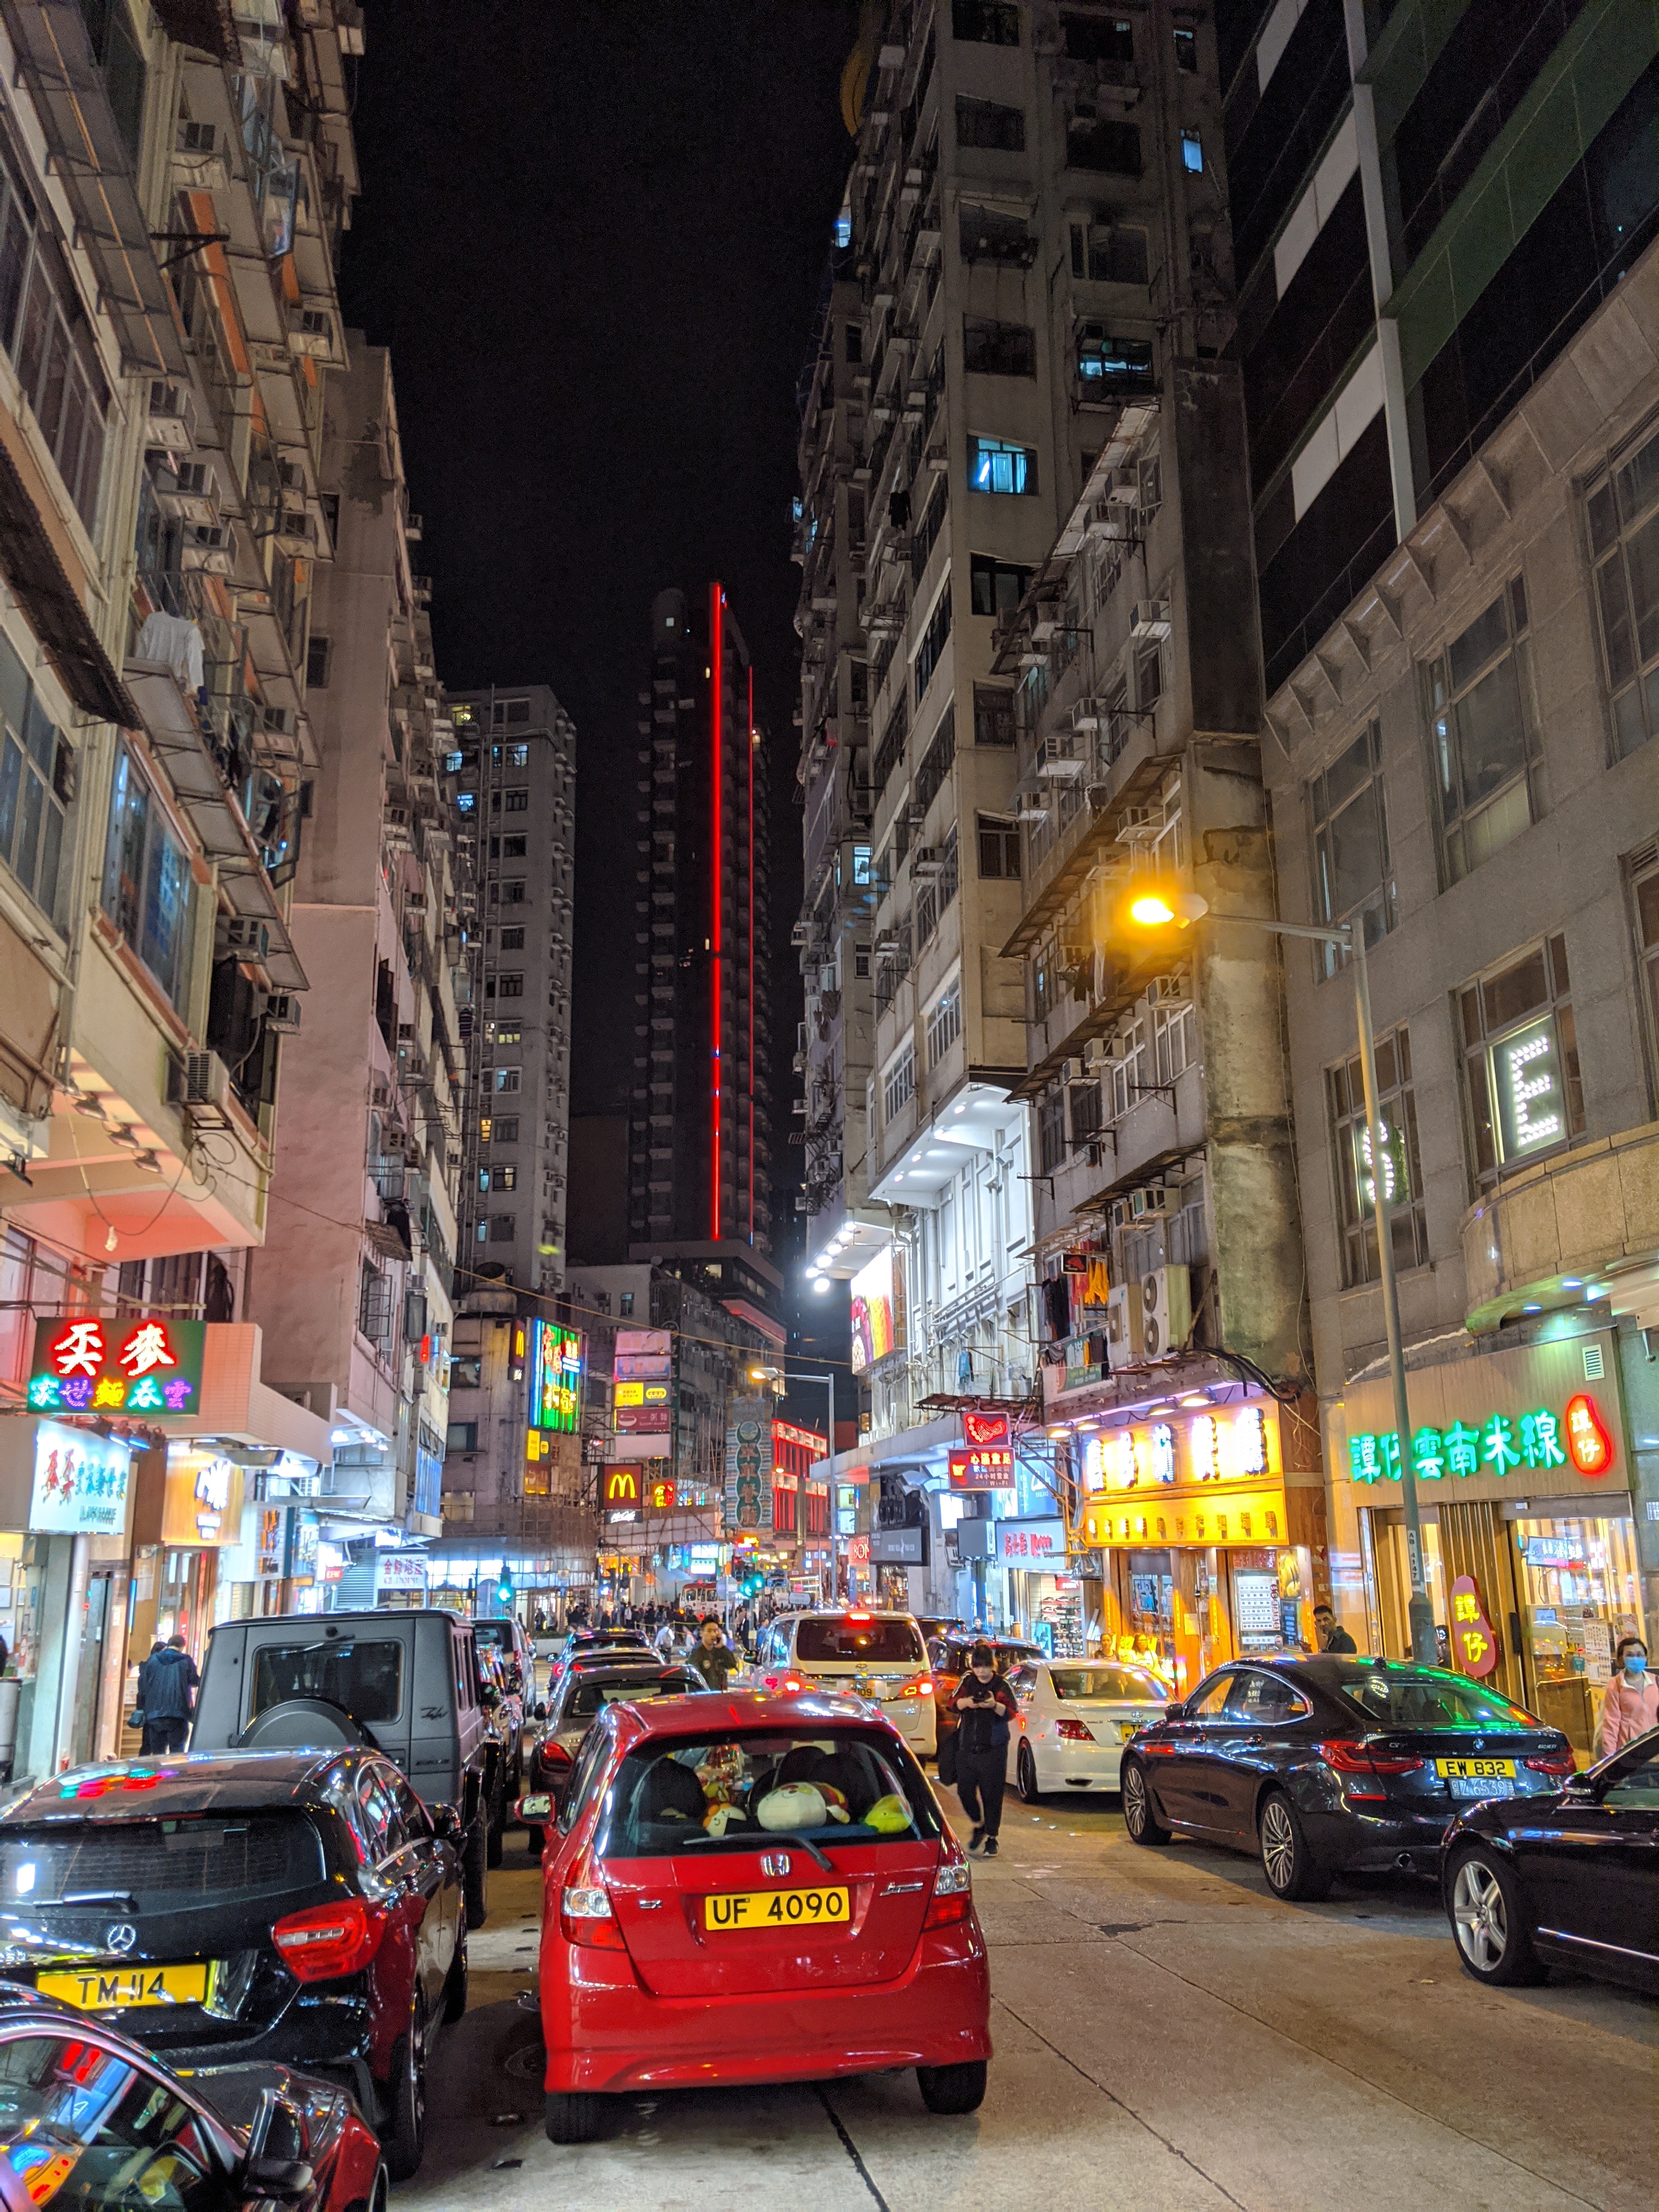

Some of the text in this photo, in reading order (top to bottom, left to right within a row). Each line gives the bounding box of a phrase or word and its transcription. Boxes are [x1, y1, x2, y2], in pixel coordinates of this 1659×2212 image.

[1571, 1408, 1601, 1463] 譚仔
[1409, 1533, 1415, 1544] AB
[1454, 1595, 1488, 1663] 譚仔
[1446, 1761, 1506, 1775] EW 832
[713, 1892, 843, 1924] UF 4090
[77, 1972, 165, 2004] TM 114
